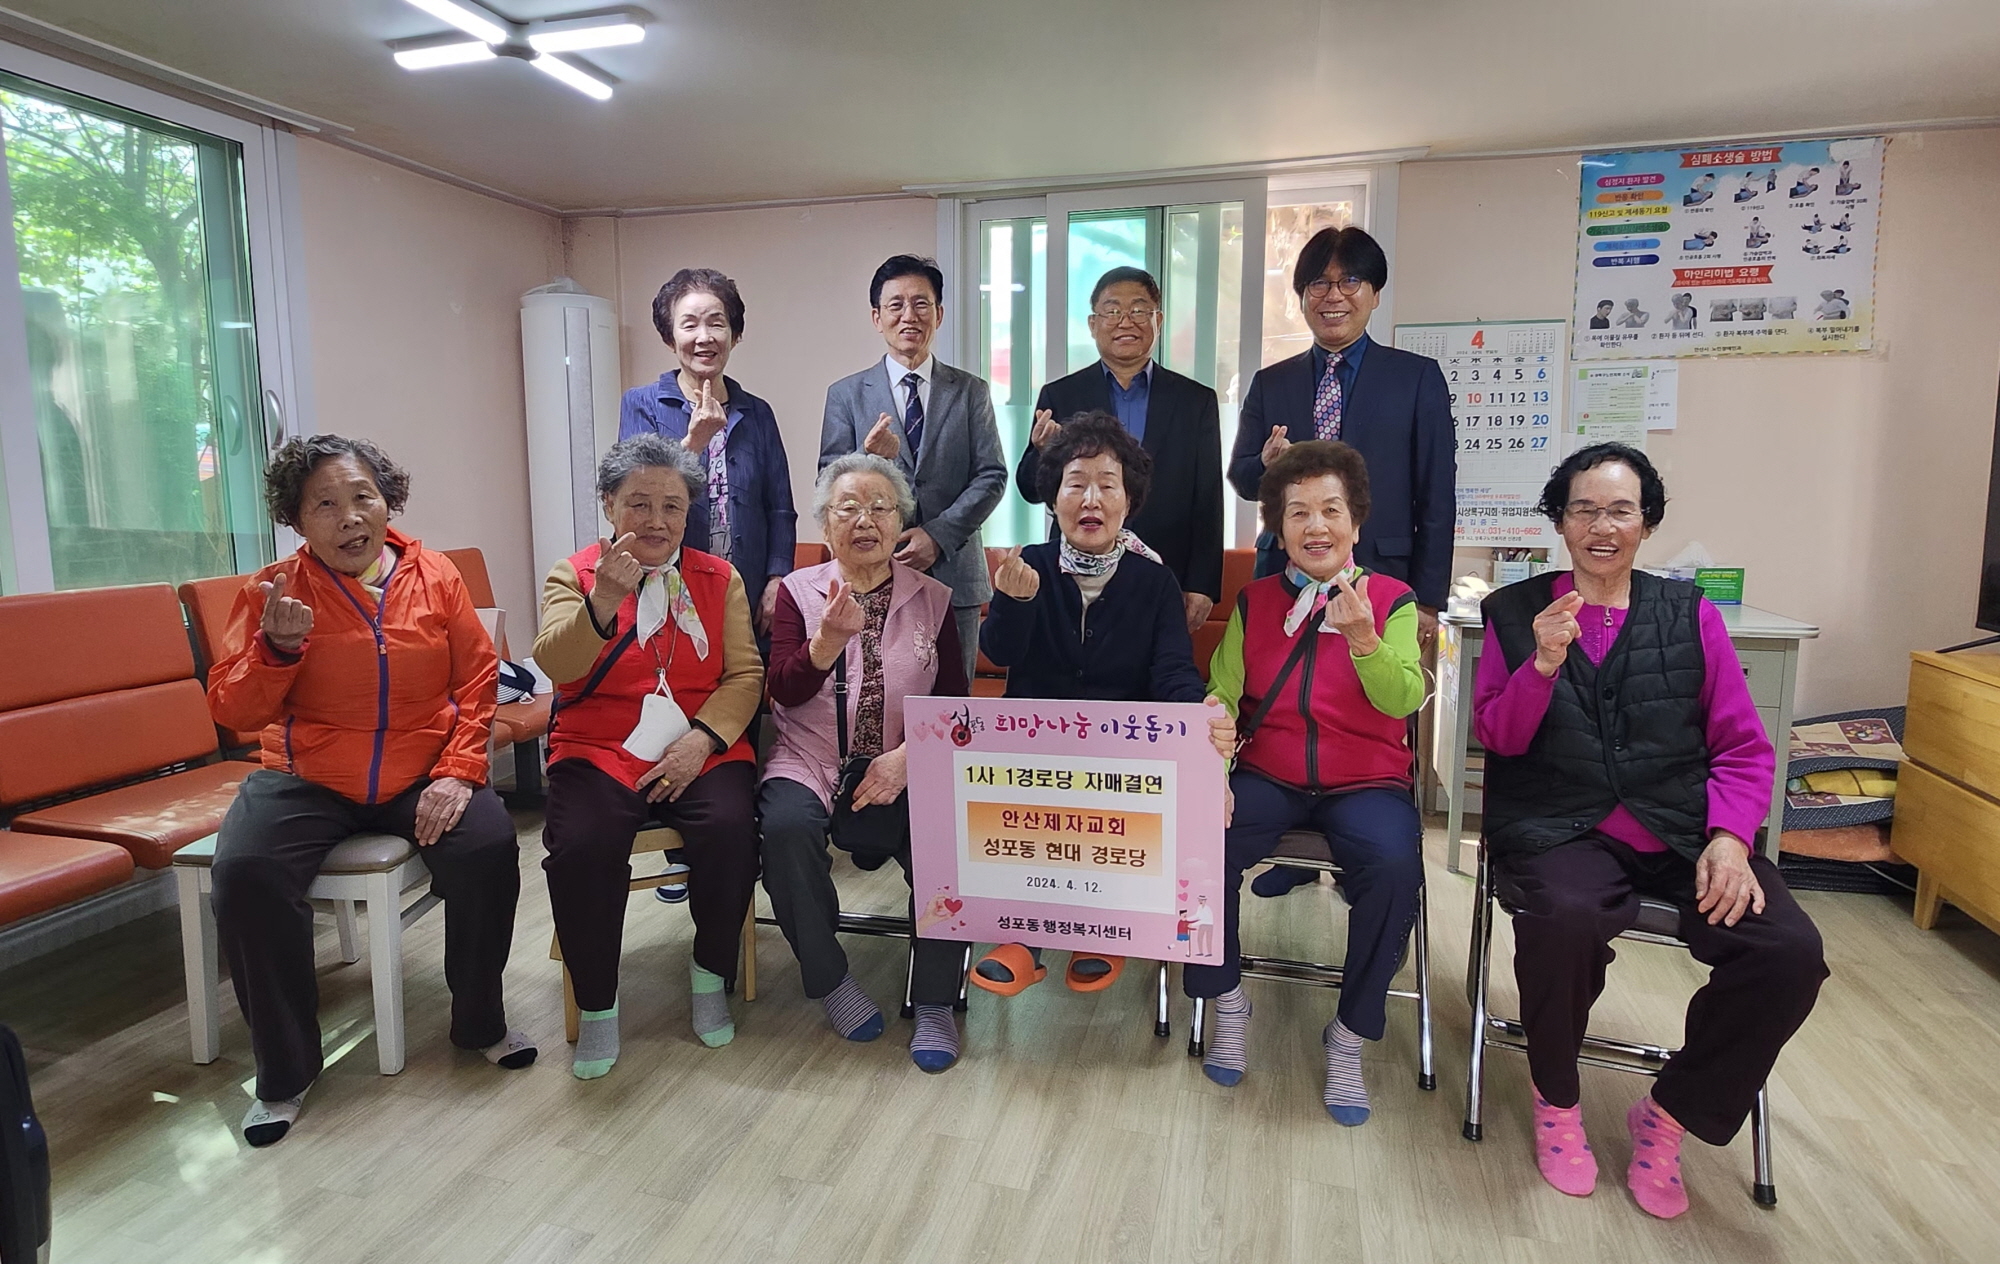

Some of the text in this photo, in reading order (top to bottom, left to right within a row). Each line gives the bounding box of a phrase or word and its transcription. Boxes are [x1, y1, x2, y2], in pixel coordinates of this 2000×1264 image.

[1690, 150, 1772, 166] 심폐소생술 방법
[1625, 207, 1652, 215] 제세동기
[1684, 268, 1759, 279] 하인리히법 요령
[1470, 330, 1484, 349] 4
[1450, 368, 1546, 381] 2 3 4 5 6
[1450, 391, 1549, 404] 9 10 11 12 13
[1453, 414, 1549, 427] 6 17 18 19 20
[1454, 437, 1548, 450] 3 24 25 26 27
[1456, 507, 1544, 517] 시상록구지회·취업지원센터
[1473, 527, 1542, 535] FAX:031-410-6622
[995, 712, 1092, 739] 희망나눔
[1100, 715, 1187, 742] 이웃돕기
[966, 766, 1162, 794] 1사 1경로당 자매결연
[1002, 810, 1125, 836] 안산제자교회
[984, 838, 1146, 868] 성포동 현대 경로당
[1026, 876, 1102, 893] 2024. 4. 12.
[997, 916, 1132, 940] 성포동 행정복지센터
